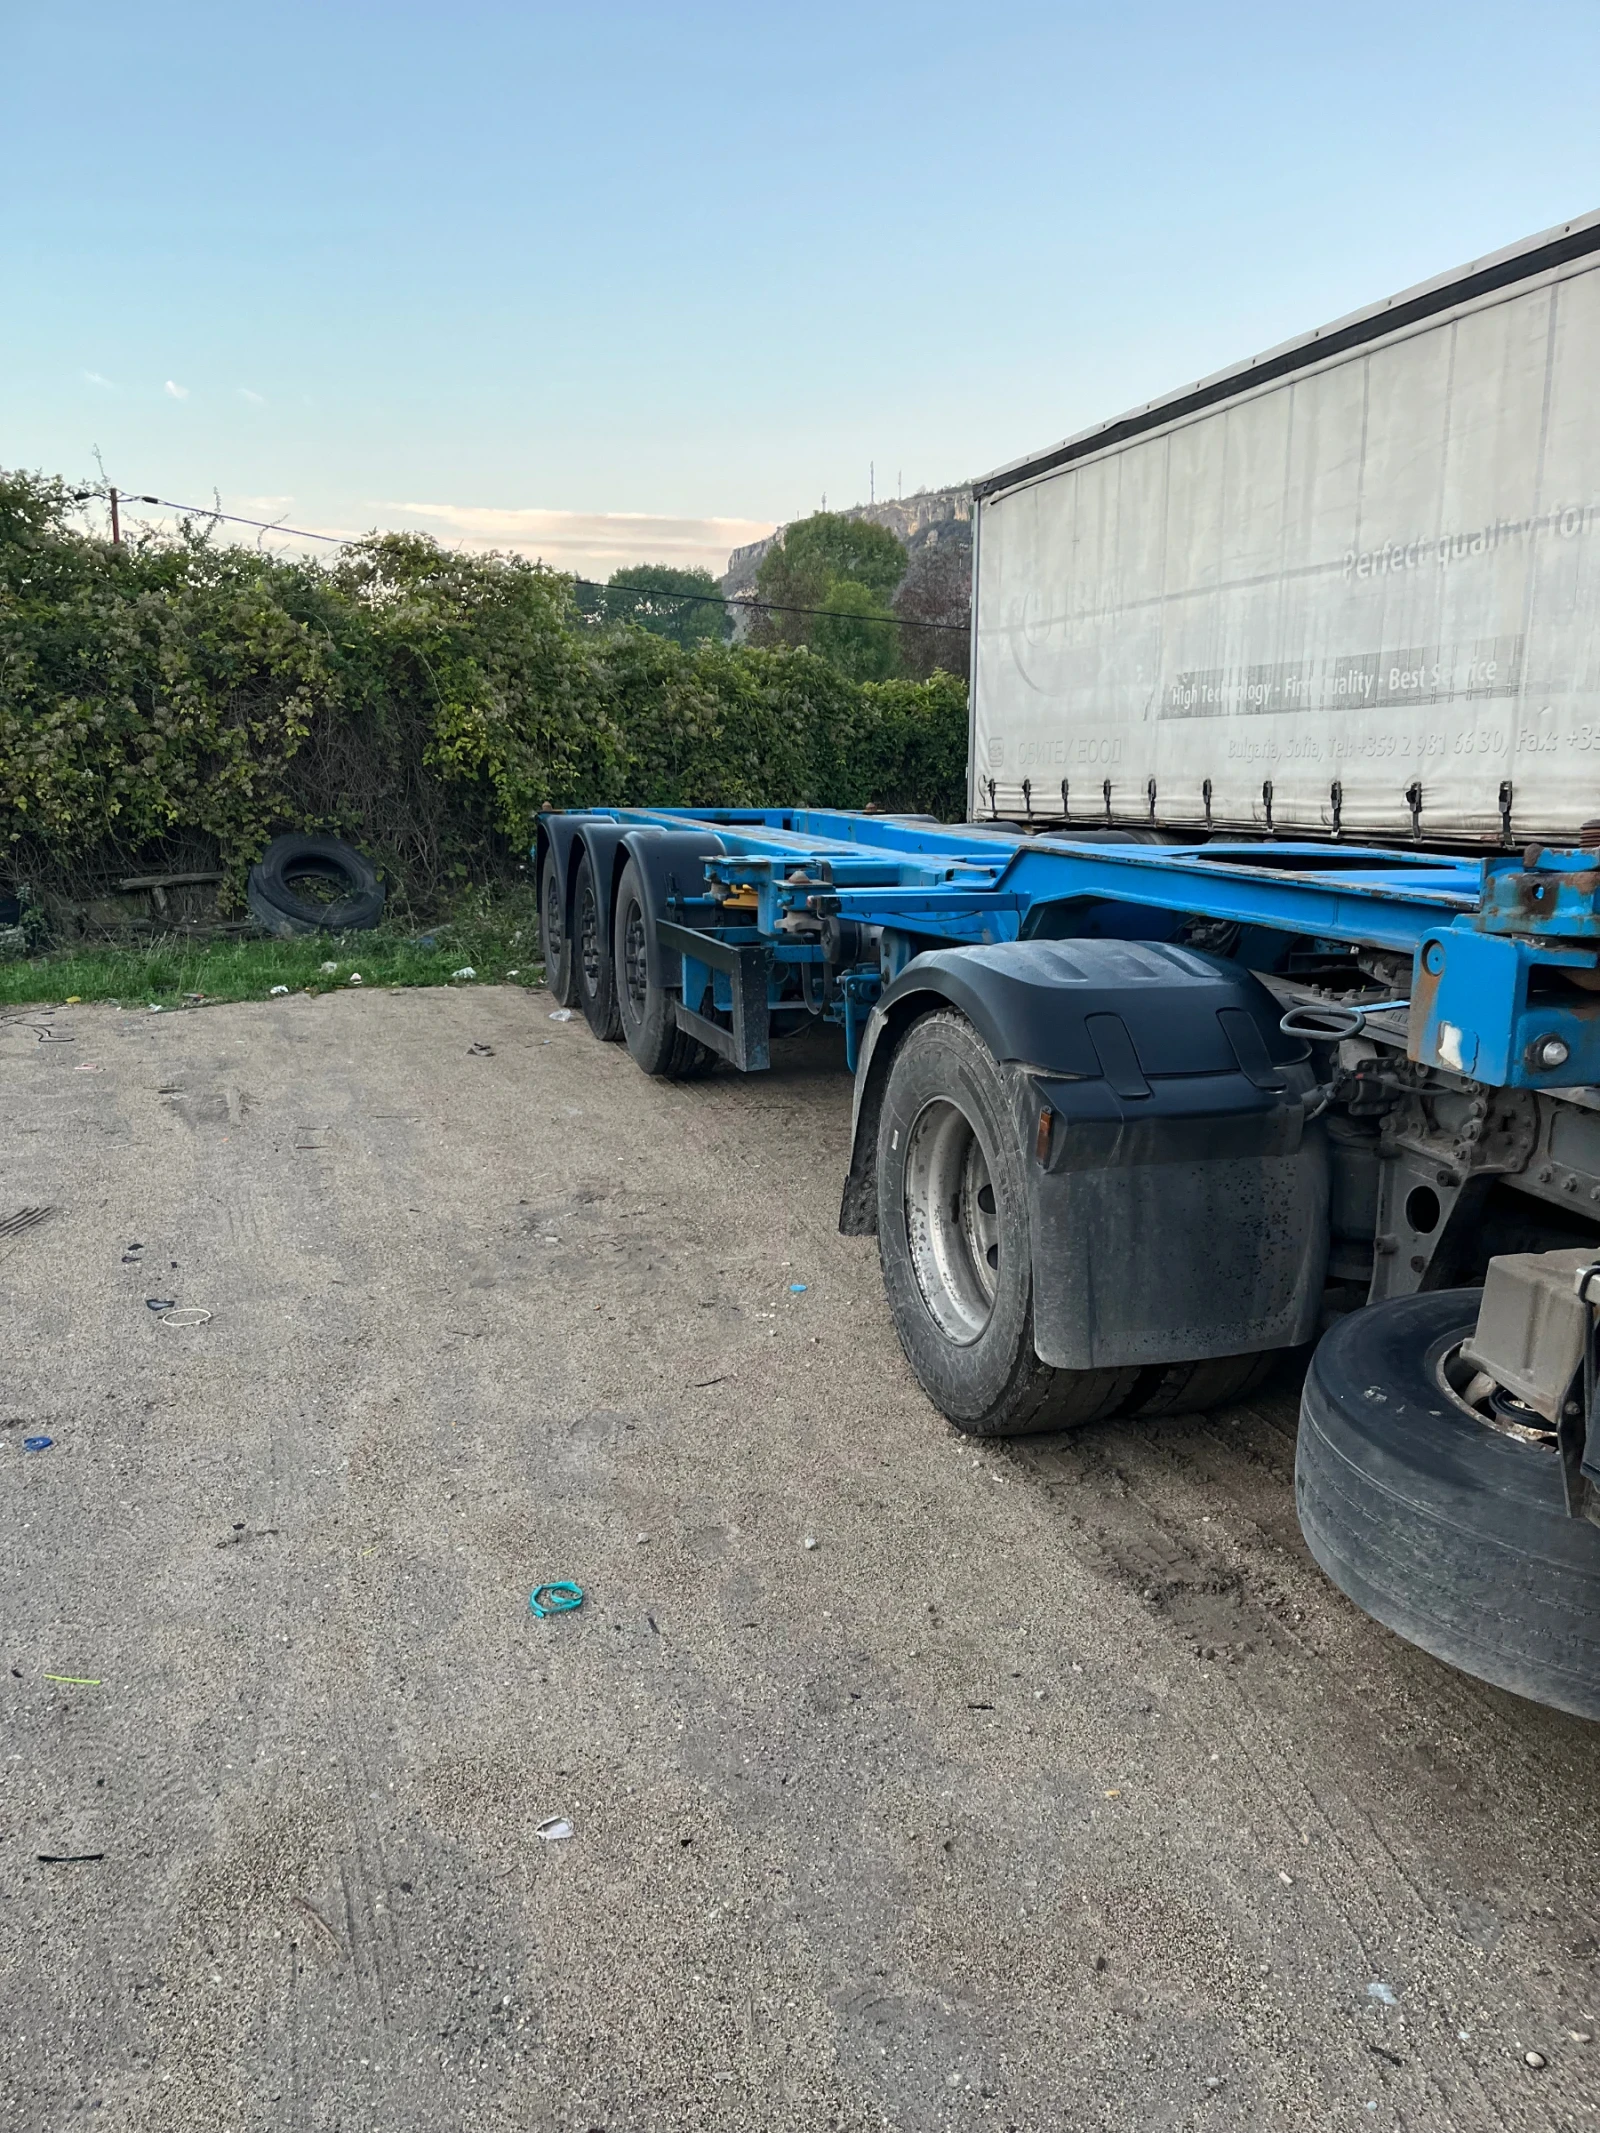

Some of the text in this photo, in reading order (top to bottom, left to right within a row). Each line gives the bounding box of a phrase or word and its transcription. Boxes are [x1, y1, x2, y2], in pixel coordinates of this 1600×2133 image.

[1343, 498, 1596, 582] Perfect quality for
[1172, 683, 1197, 710] High
[1202, 679, 1272, 705] Techology
[1319, 669, 1374, 699] uality
[1389, 665, 1425, 690] Best
[1430, 656, 1498, 687] Serice
[1357, 735, 1397, 757] +359
[1400, 736, 1412, 757] 2
[1416, 733, 1446, 757] 981
[1454, 731, 1475, 755] 66
